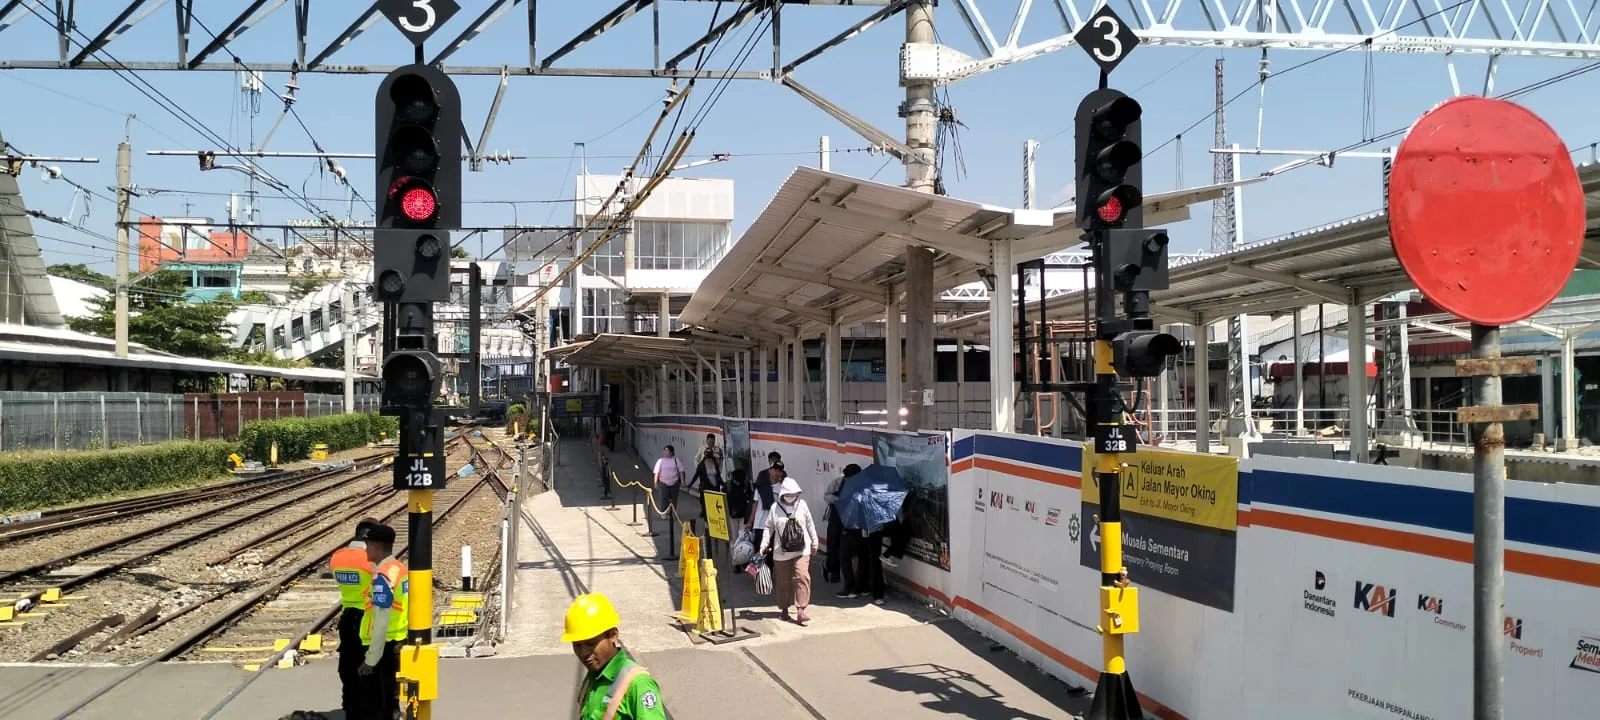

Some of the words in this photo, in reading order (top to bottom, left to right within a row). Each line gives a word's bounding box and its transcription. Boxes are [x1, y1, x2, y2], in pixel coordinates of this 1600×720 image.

[398, 0, 436, 32] 3
[1093, 15, 1123, 62] 3
[1108, 427, 1123, 439] JL
[1105, 440, 1127, 451] 32B
[410, 458, 428, 471] JL
[1141, 460, 1165, 475] Keluar
[1166, 463, 1186, 479] Arah
[405, 473, 433, 486] 12B
[1126, 472, 1135, 490] A
[1141, 477, 1162, 493] Jalan
[1163, 480, 1189, 499] Mayor
[1190, 484, 1216, 505] Oking
[1122, 532, 1147, 550] Musala
[1147, 538, 1189, 562] Sementara
[1303, 589, 1337, 608] Danantara
[1354, 580, 1397, 618] KAI
[1417, 594, 1443, 615] KAI
[1304, 600, 1336, 618] Indonesia
[1434, 616, 1467, 631] Commuter
[1503, 616, 1522, 640] AI
[1510, 641, 1544, 658] Properti
[1347, 688, 1385, 710] PEKERJAAN
